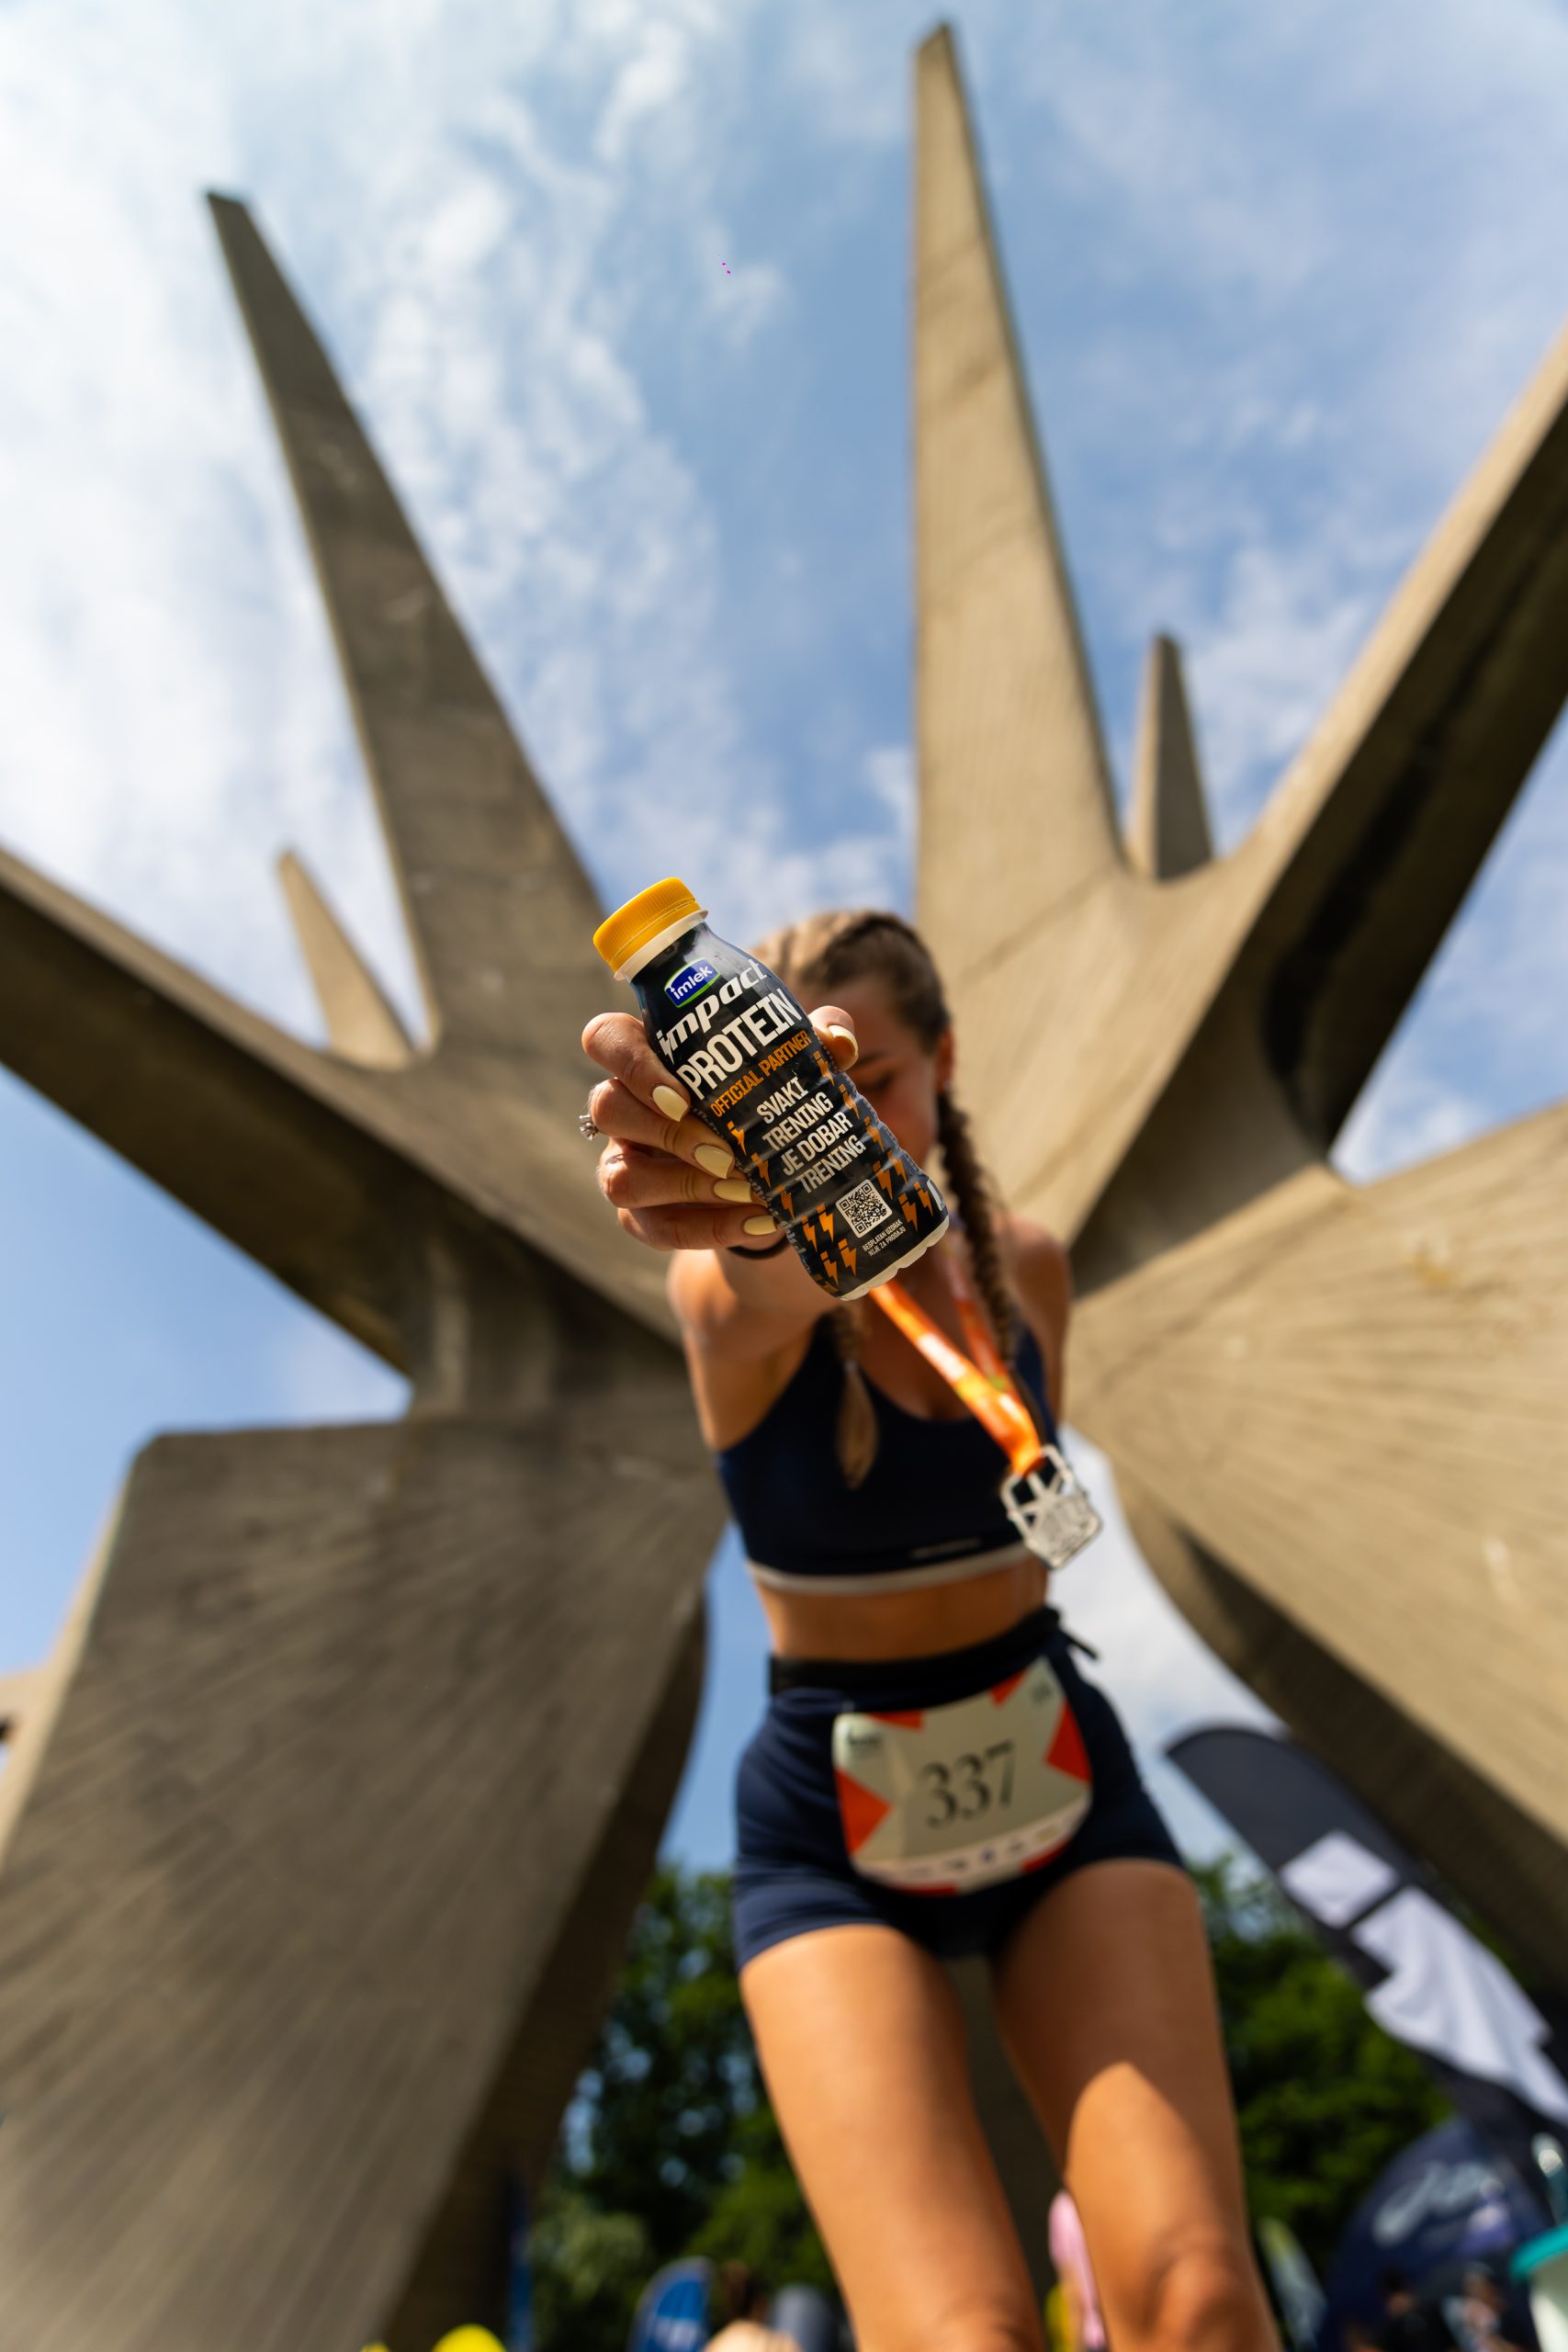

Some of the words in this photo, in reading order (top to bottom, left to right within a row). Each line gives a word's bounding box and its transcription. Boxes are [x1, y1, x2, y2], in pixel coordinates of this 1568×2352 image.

[656, 959, 767, 1065] impact
[671, 966, 713, 1000] imlek
[676, 988, 802, 1101] PROTEIN
[710, 1069, 764, 1117] OFFICIAL
[758, 1030, 812, 1076] PARTNER
[756, 1077, 809, 1124] SVAKI
[761, 1091, 834, 1151] TRENING
[781, 1148, 804, 1176] JE
[796, 1112, 853, 1162] DOBAR
[795, 1135, 866, 1193] TRENING
[863, 1230, 886, 1250] BESPLATAN
[921, 1740, 1017, 1830] 337
